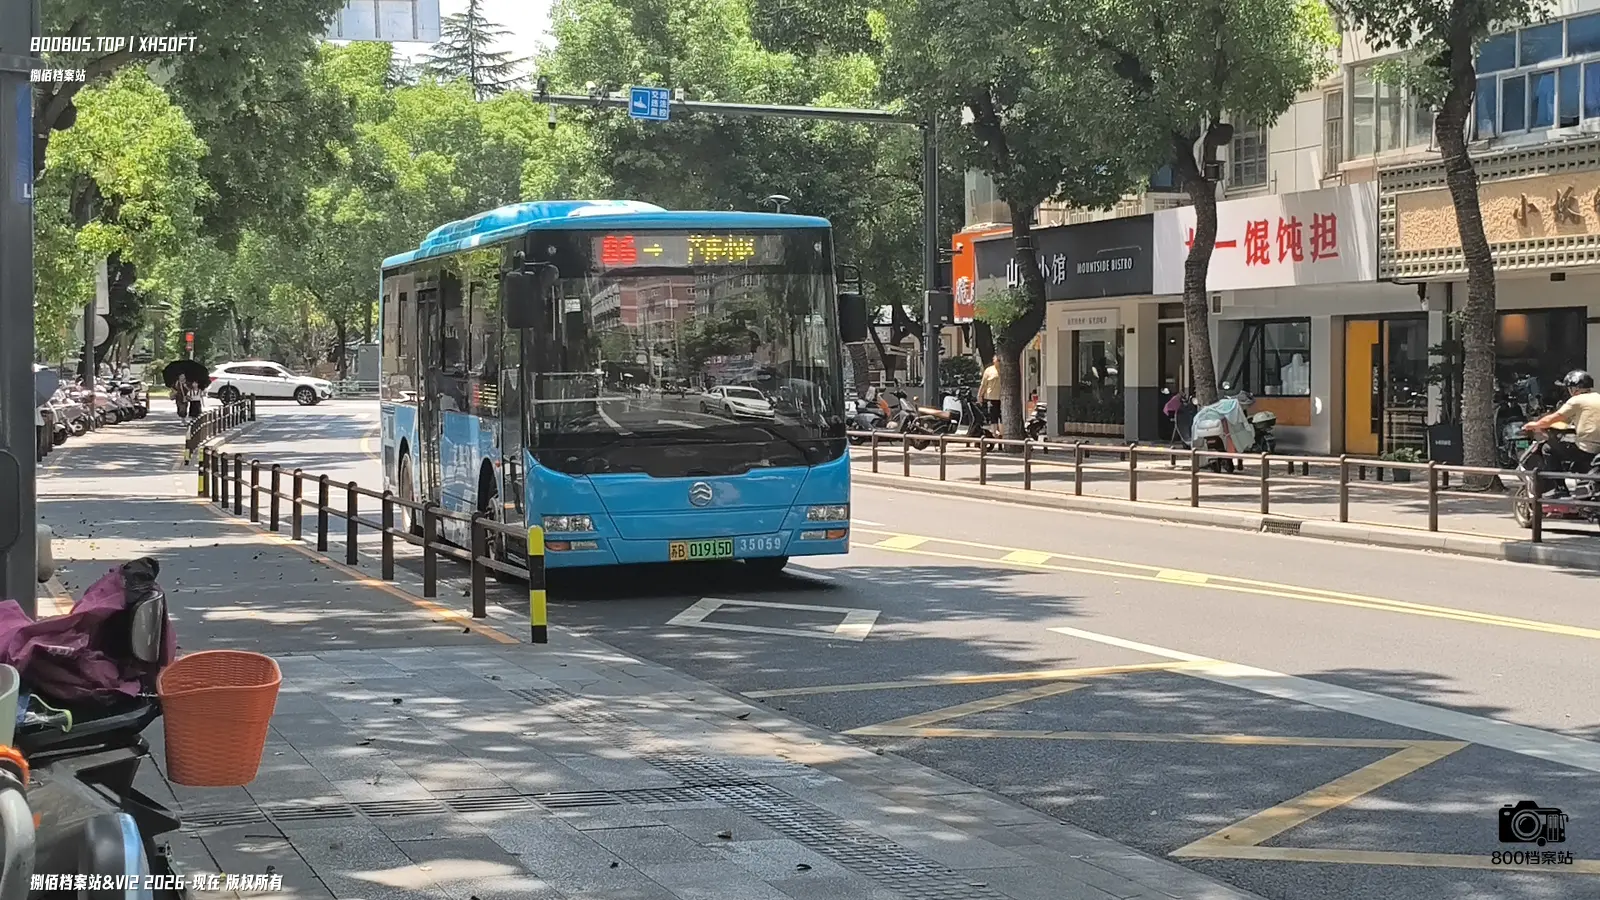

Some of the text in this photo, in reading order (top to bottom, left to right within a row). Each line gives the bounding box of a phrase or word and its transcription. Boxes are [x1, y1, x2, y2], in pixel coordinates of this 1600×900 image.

[1006, 253, 1068, 289] 山小馆
[1077, 257, 1133, 274] MOUNTSIDE BISTRO
[690, 541, 732, 557] 01915D
[740, 538, 781, 551] 35059
